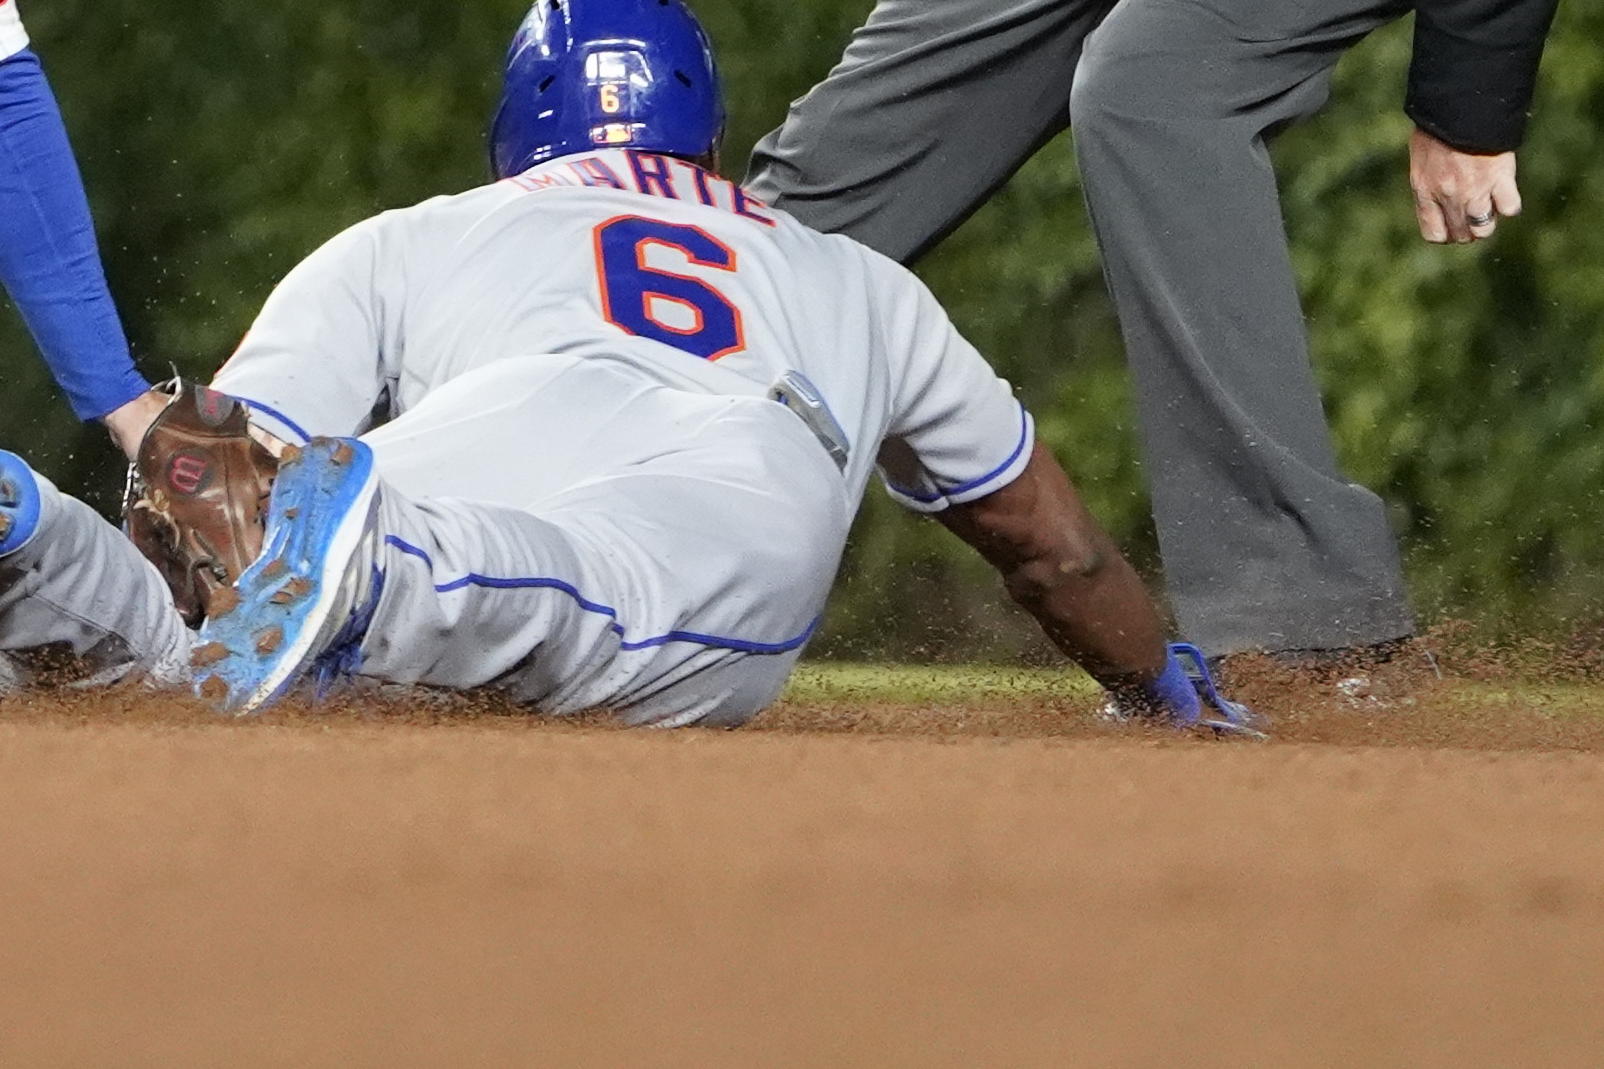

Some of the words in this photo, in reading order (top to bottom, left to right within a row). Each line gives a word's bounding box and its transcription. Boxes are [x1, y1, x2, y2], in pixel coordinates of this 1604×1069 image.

[599, 84, 621, 114] 6
[496, 149, 777, 228] MARTE
[592, 214, 747, 362] 6
